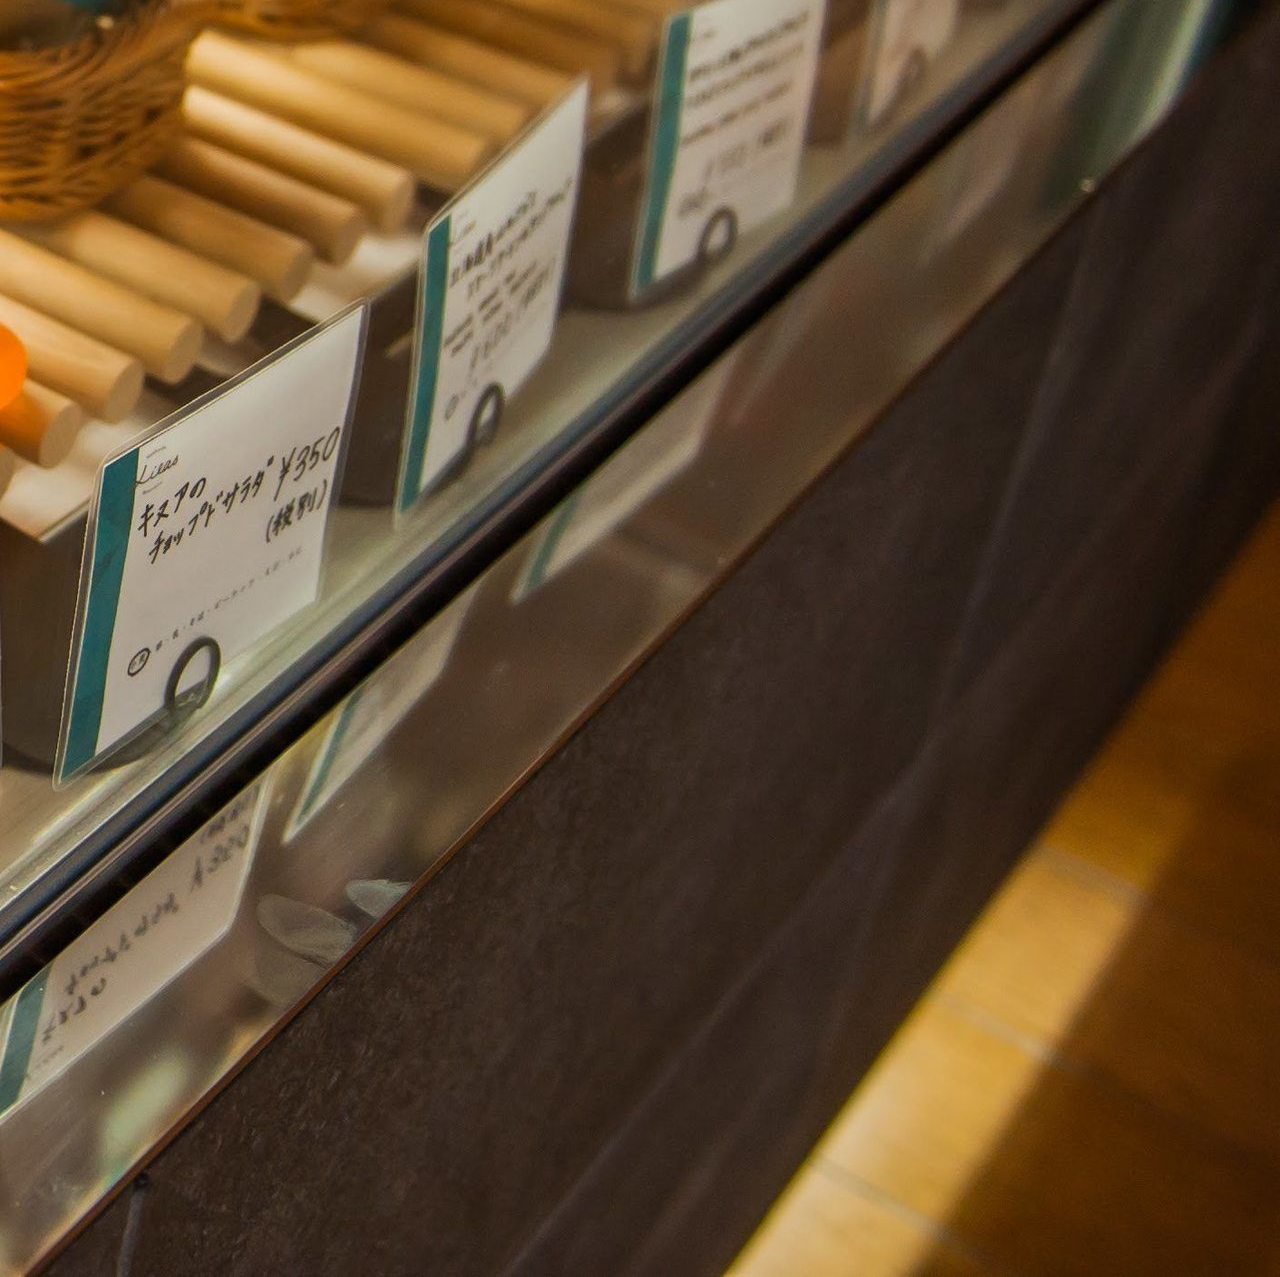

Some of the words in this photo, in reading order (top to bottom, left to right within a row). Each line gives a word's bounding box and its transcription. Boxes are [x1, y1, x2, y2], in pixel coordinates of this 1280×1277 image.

[135, 454, 180, 487] Lilas
[137, 476, 208, 538] キヌアの
